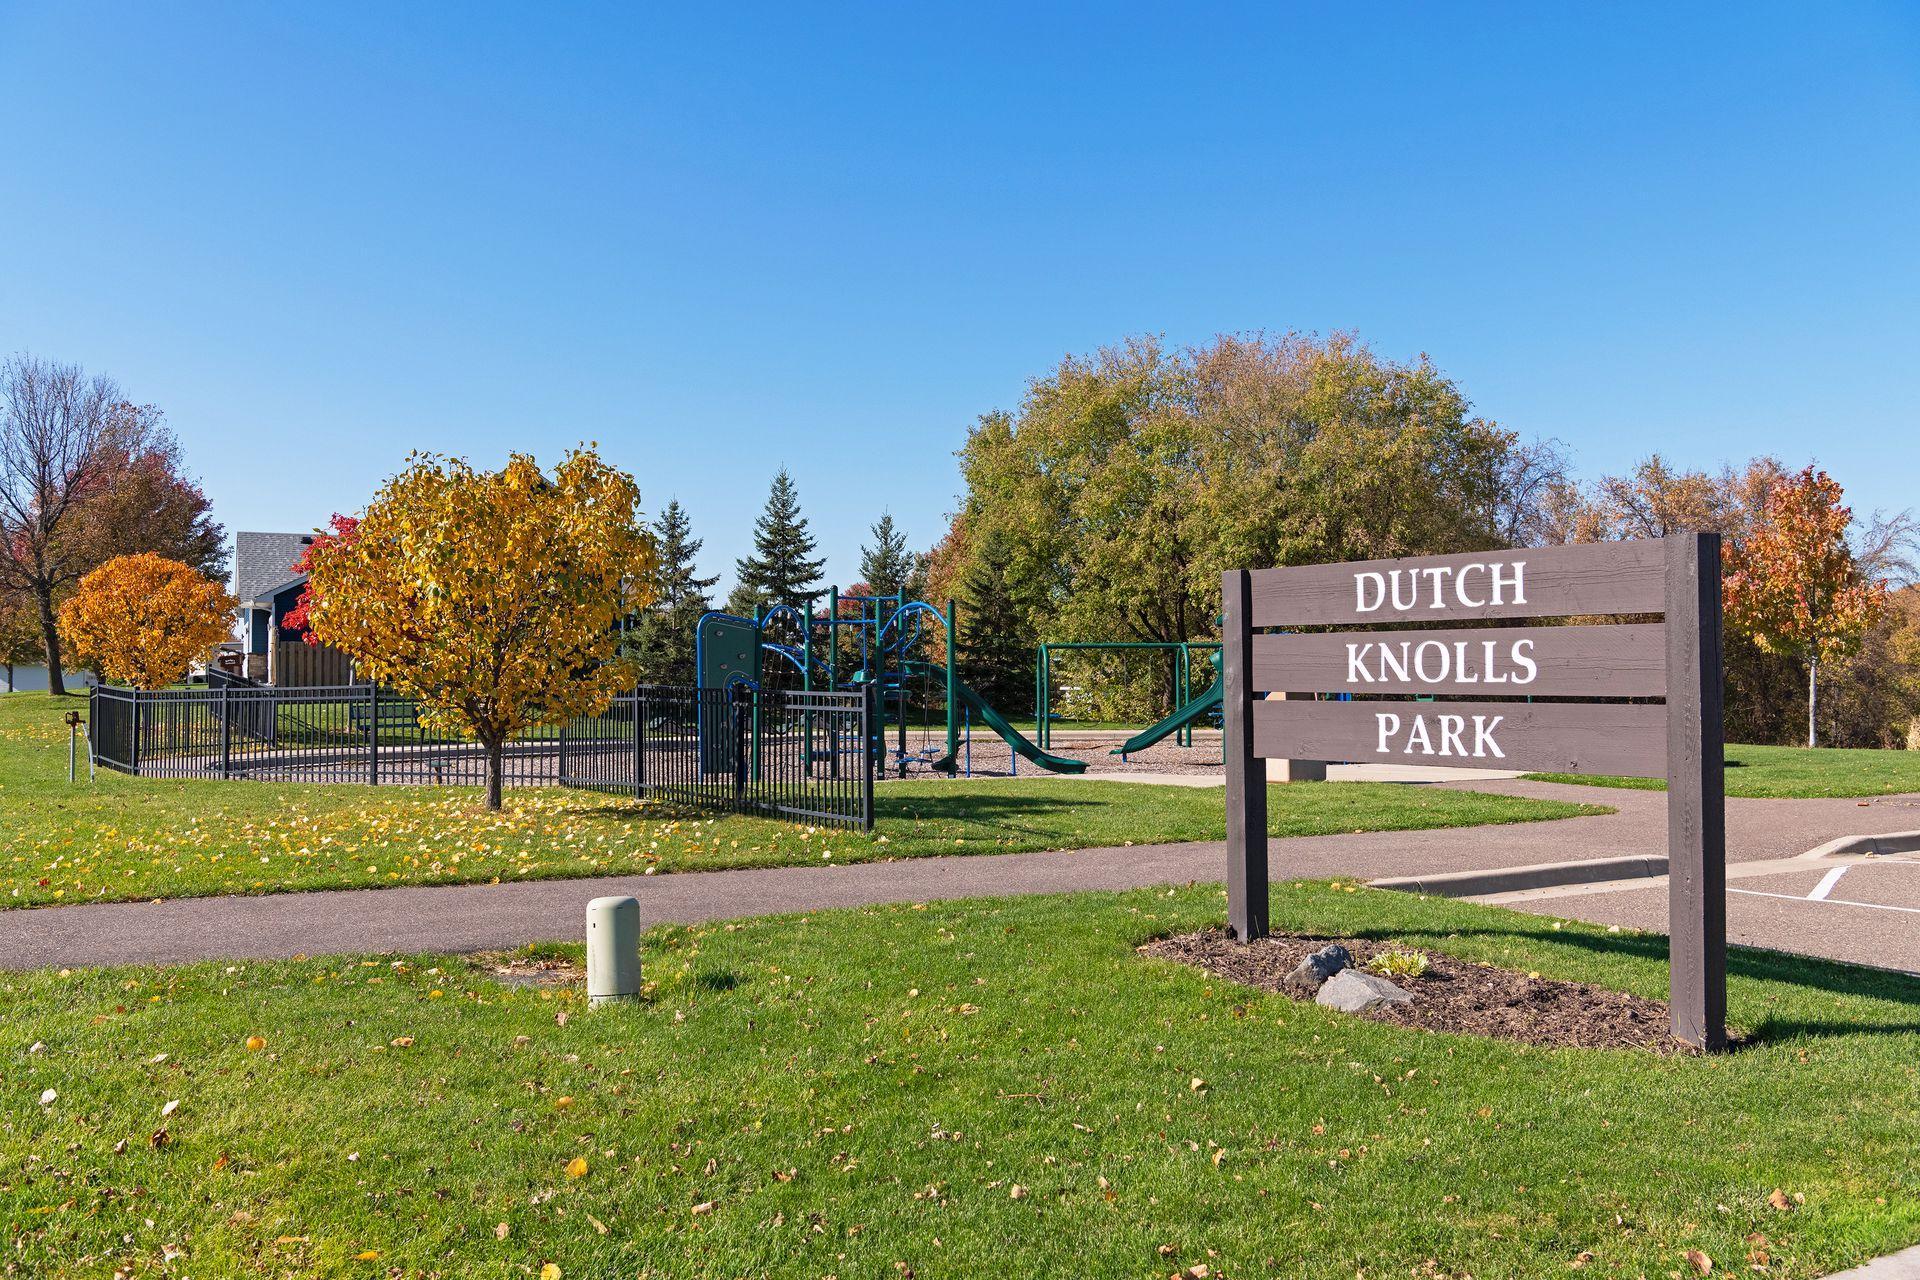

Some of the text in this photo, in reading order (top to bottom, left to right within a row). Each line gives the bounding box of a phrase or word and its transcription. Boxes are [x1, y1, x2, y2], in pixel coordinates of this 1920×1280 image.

[1354, 562, 1528, 612] DUTCH
[1345, 639, 1538, 684] KNOLLS
[1375, 713, 1506, 758] PARK
